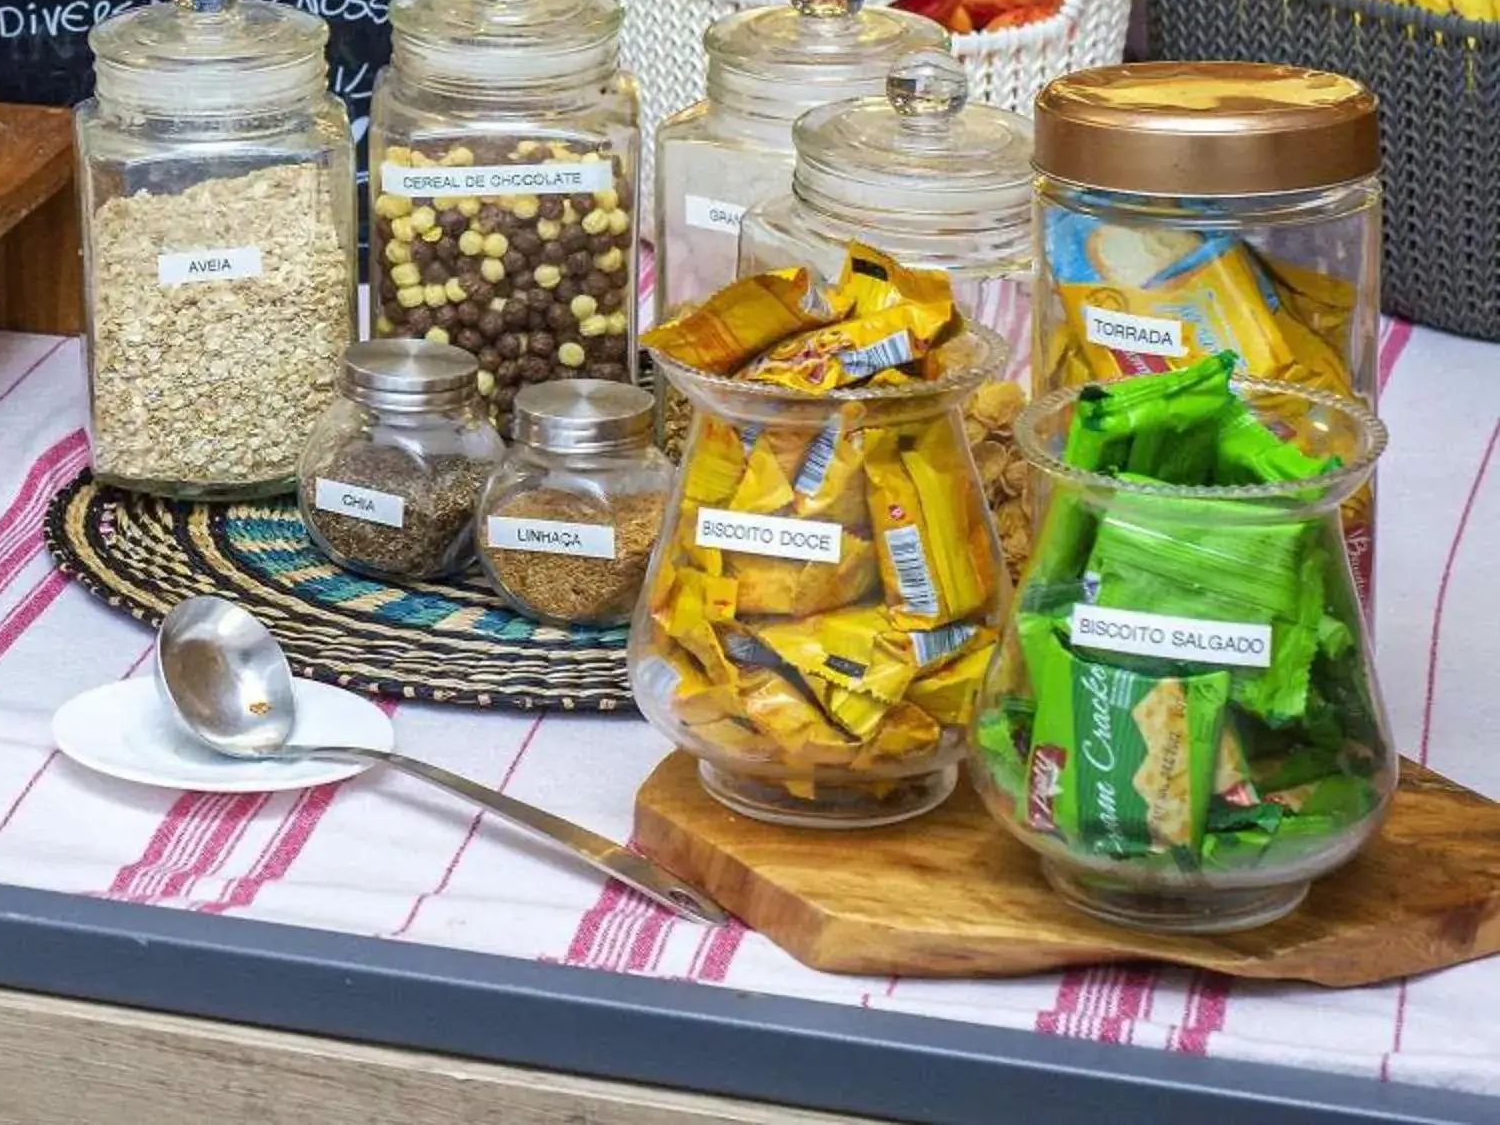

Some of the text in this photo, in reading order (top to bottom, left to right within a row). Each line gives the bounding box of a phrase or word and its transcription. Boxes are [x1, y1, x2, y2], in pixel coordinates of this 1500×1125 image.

[403, 171, 582, 191] CEREAL DE CHOCOLATE
[188, 258, 232, 273] AVEIA
[1093, 318, 1173, 347] TORRADA
[341, 494, 375, 512] CHIA
[516, 528, 583, 547] LINHAÇA
[702, 520, 832, 551] BISCOITO DOCE
[1079, 617, 1265, 654] BISCOITO SALGADO
